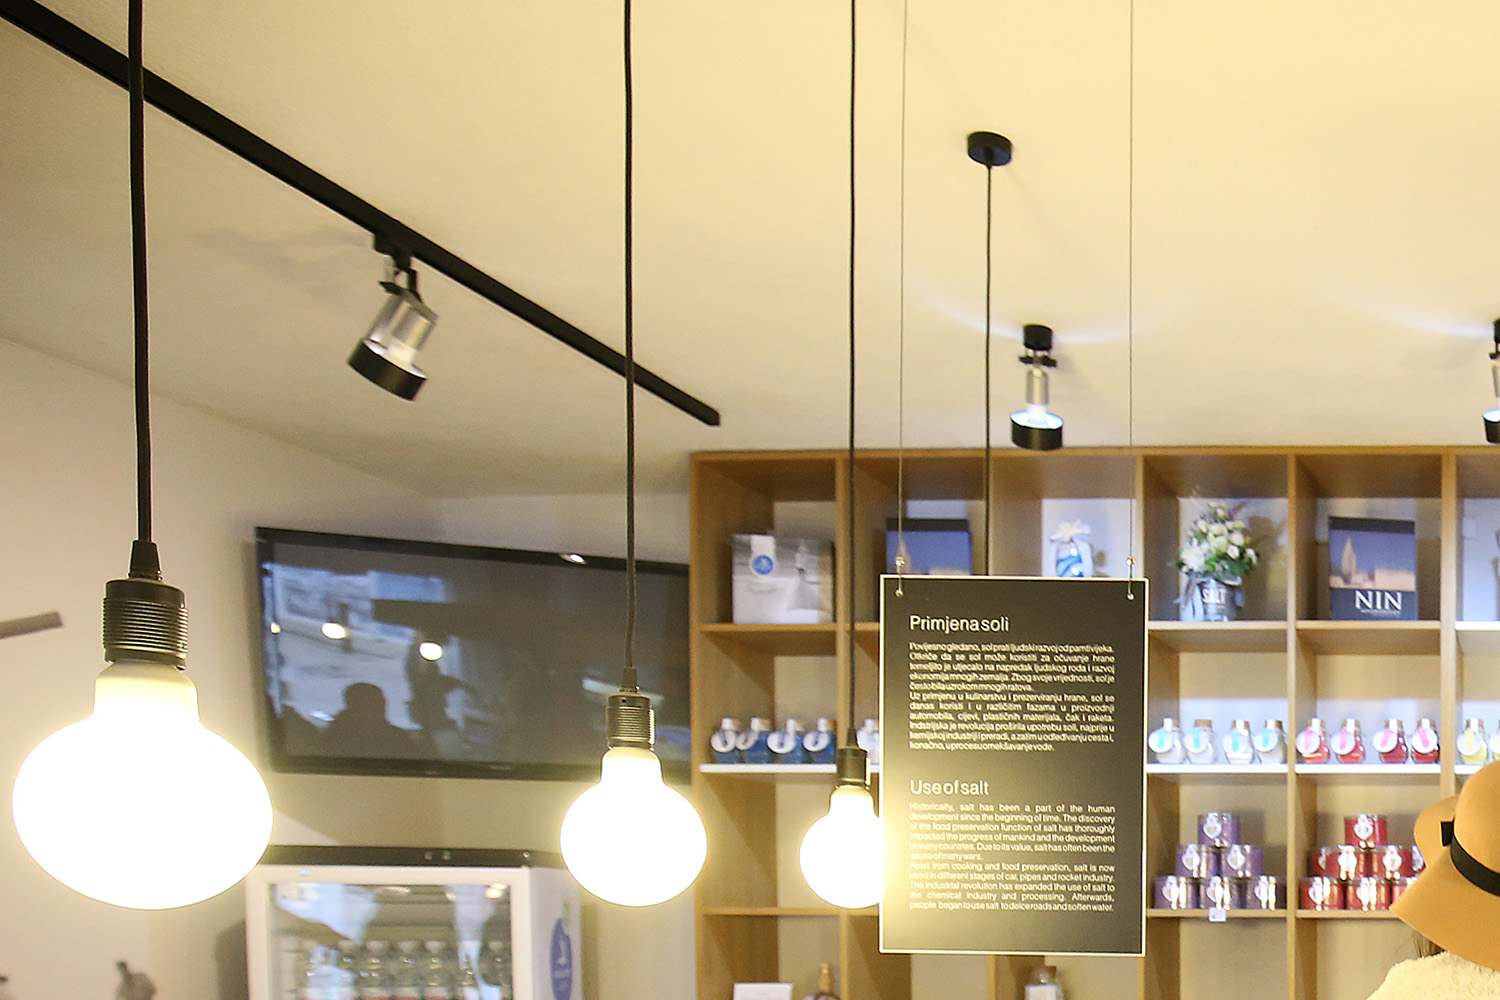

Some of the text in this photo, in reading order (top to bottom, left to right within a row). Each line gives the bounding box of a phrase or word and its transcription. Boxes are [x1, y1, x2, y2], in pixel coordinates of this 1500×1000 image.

[1355, 590, 1402, 610] NIN
[909, 615, 1009, 634] Primjena soli
[910, 779, 989, 796] Use of salt
